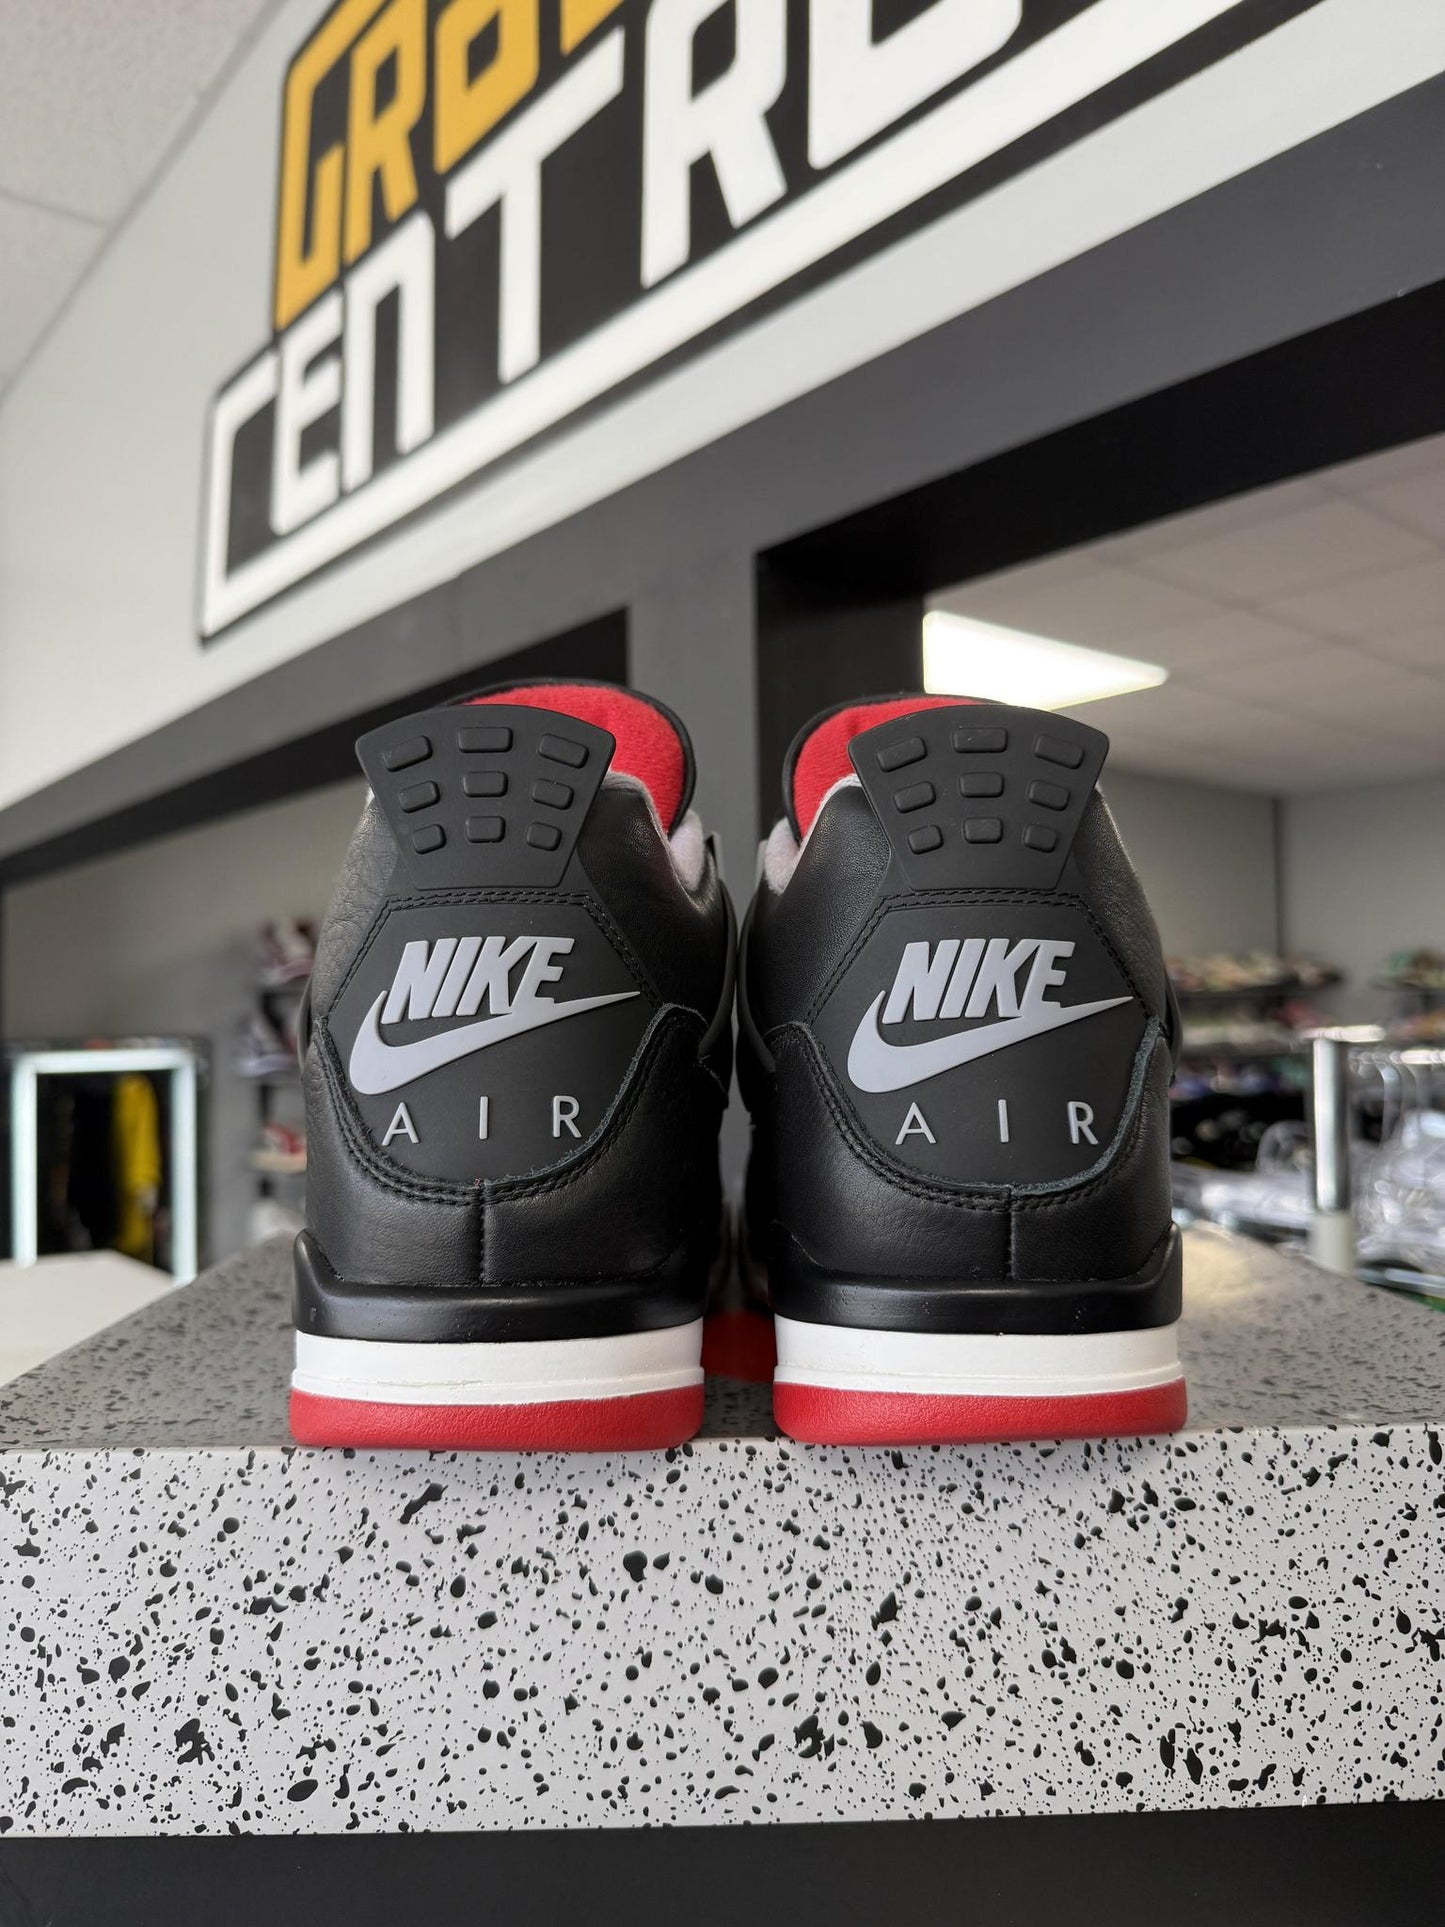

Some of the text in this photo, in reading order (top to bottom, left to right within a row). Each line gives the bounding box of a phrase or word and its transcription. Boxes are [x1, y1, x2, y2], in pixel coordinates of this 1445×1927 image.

[275, 0, 624, 331] GR
[382, 935, 576, 1025] NIKE
[882, 938, 1076, 1025] NIKE
[381, 1095, 583, 1146] AIR
[895, 1099, 1099, 1146] AIR
